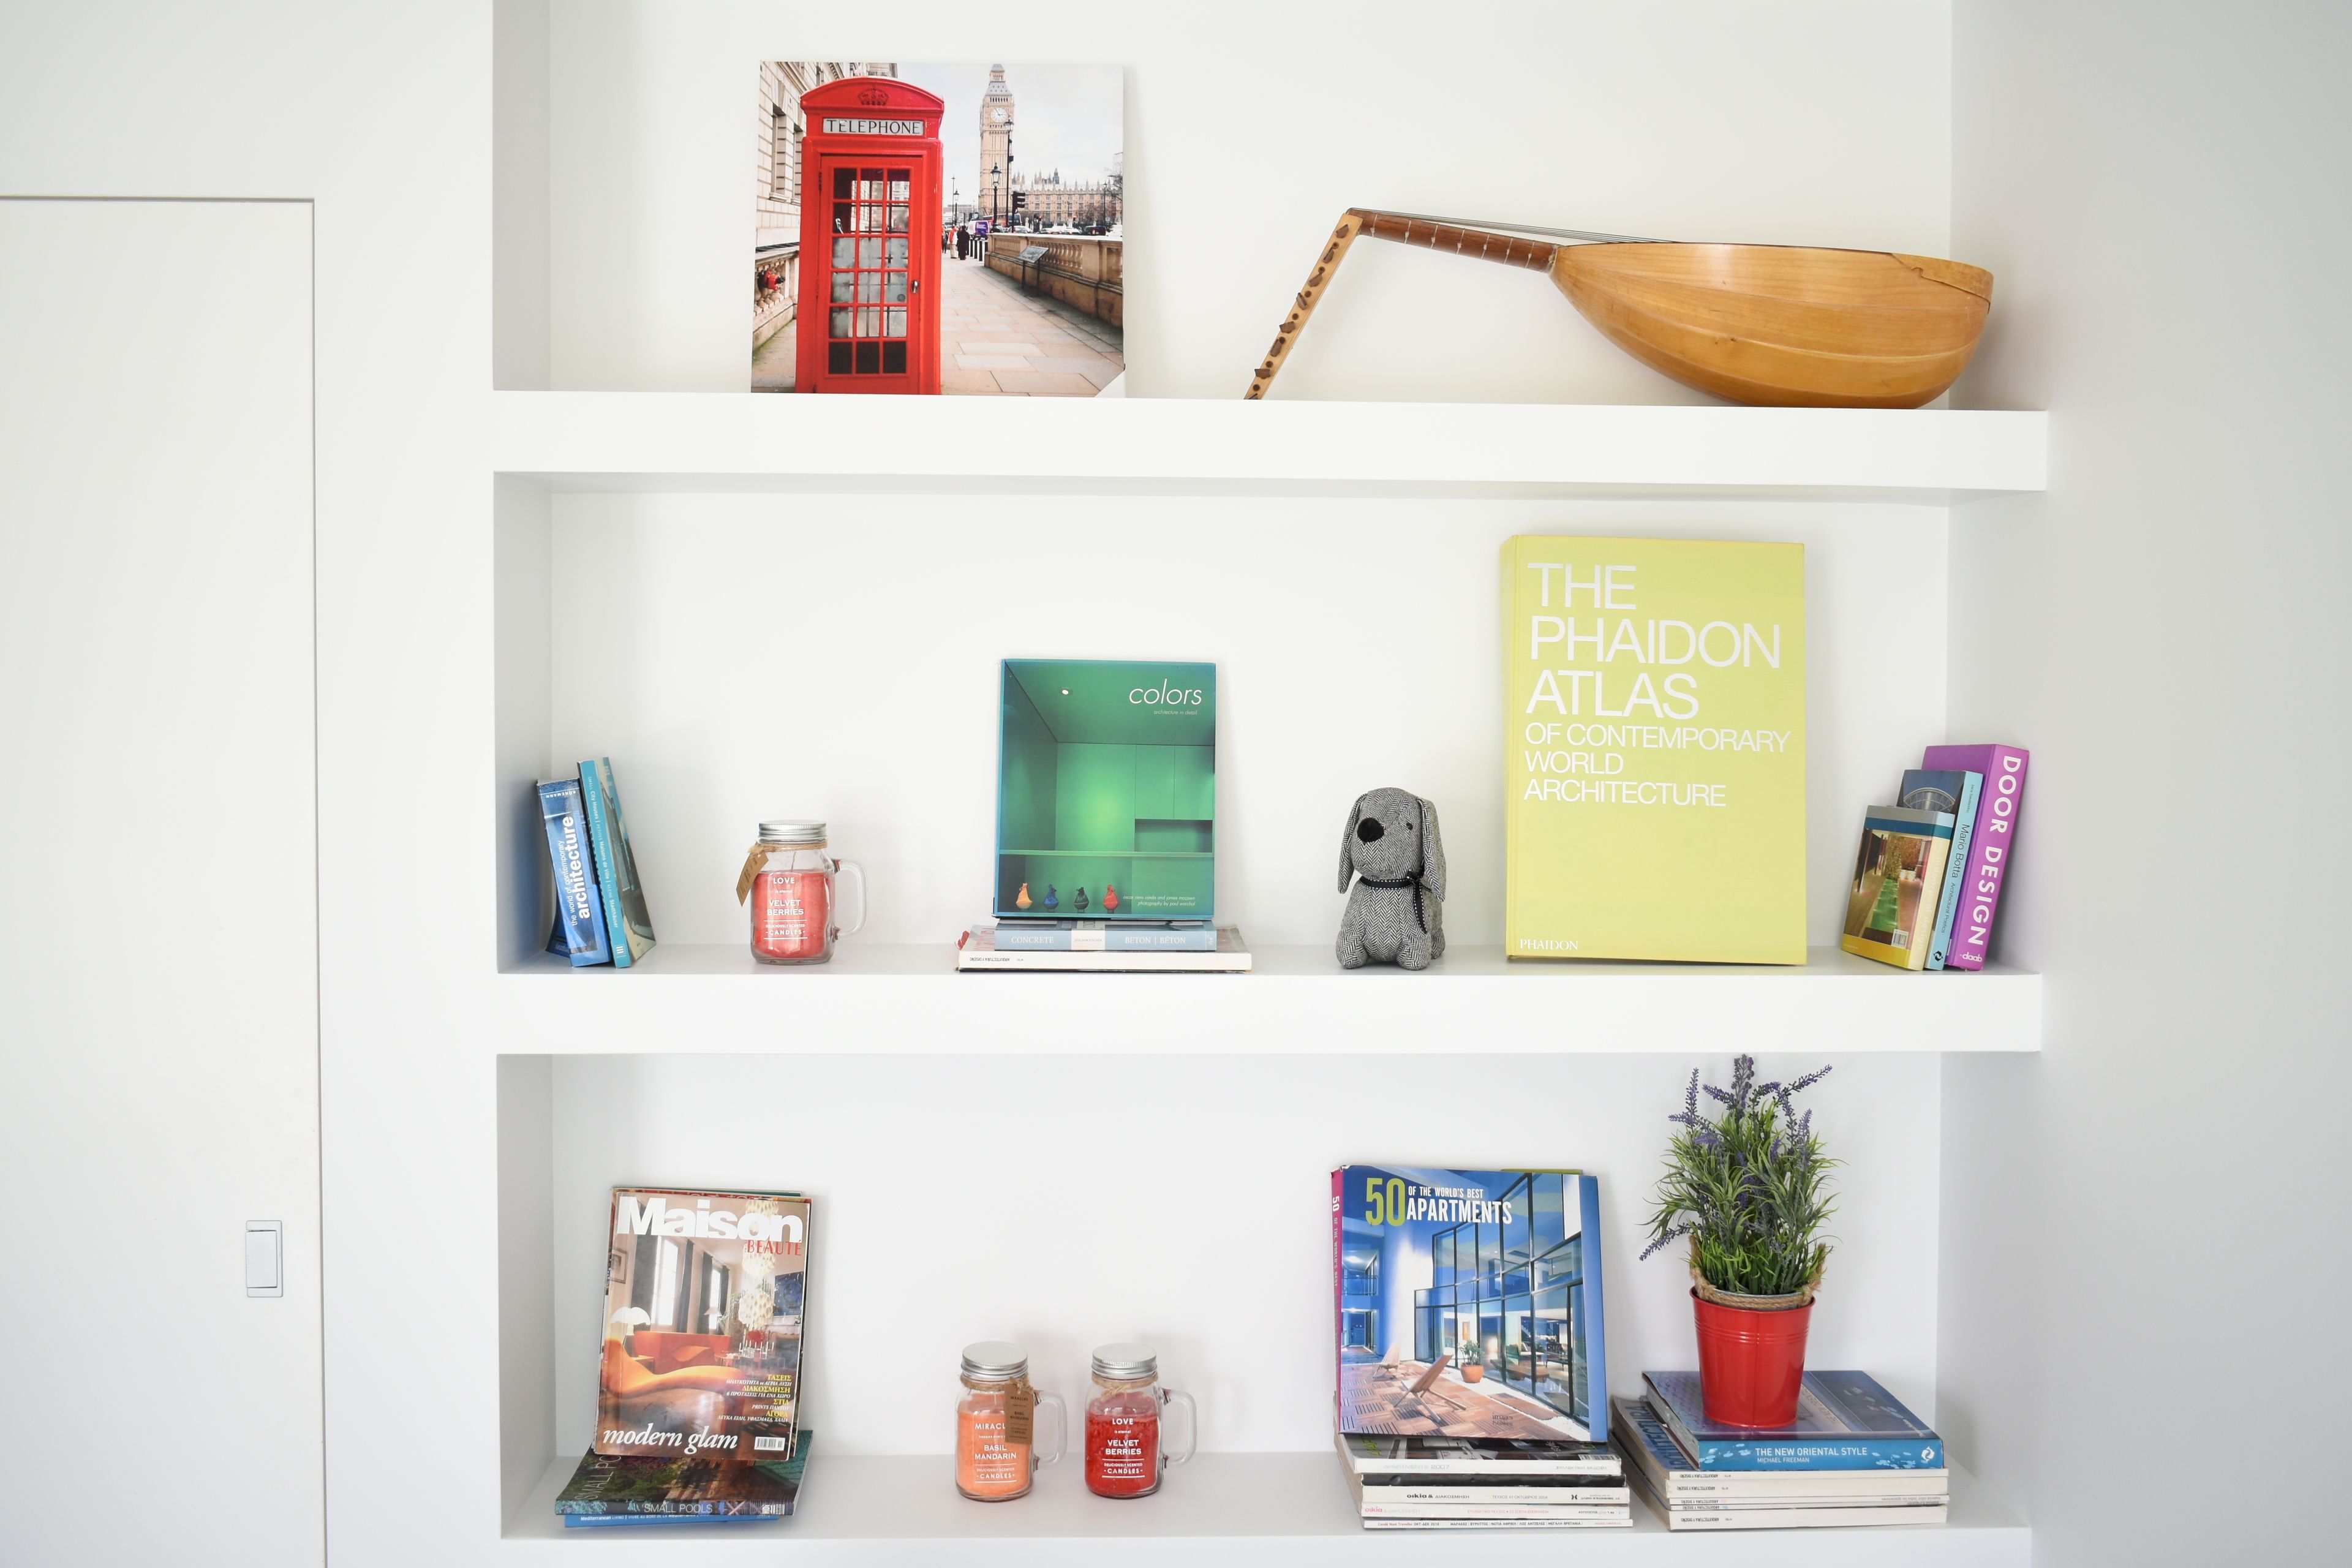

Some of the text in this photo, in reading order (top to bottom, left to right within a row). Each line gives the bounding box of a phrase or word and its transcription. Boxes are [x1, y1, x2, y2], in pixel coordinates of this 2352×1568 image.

[826, 119, 921, 134] TELEPHONE
[1528, 562, 1637, 610] THE
[1531, 616, 1781, 669] PHAIDON
[1129, 678, 1202, 705] colors
[1526, 669, 1699, 720] ATLAS
[1525, 722, 1791, 753] OF CONTEMPORARY
[1525, 750, 1624, 775] WORLD
[1523, 778, 1727, 807] ARCHITECTURE
[558, 840, 570, 884] contemporary
[1967, 755, 2022, 945] DOOR DESIGN
[563, 816, 591, 919] architecture
[1941, 823, 1970, 933] Mario Botta Architectural Poetics
[567, 895, 576, 913] world
[1159, 935, 1186, 944] BÉTON
[1520, 939, 1578, 950] PHAIDON
[1962, 951, 1983, 962] daab
[1332, 1195, 1340, 1212] 50
[1365, 1177, 1405, 1227] 50
[1408, 1186, 1483, 1199] OF THE WORLD'S BEST
[617, 1196, 803, 1243] Maison
[1406, 1197, 1512, 1224] APARTMENTS
[747, 1238, 802, 1256] BEAUTÉ
[603, 1423, 737, 1455] modern glam
[1797, 1447, 1839, 1456] ORIENTAL
[575, 1471, 614, 1499] SMALL
[643, 1504, 713, 1513] SMALL POOLS
